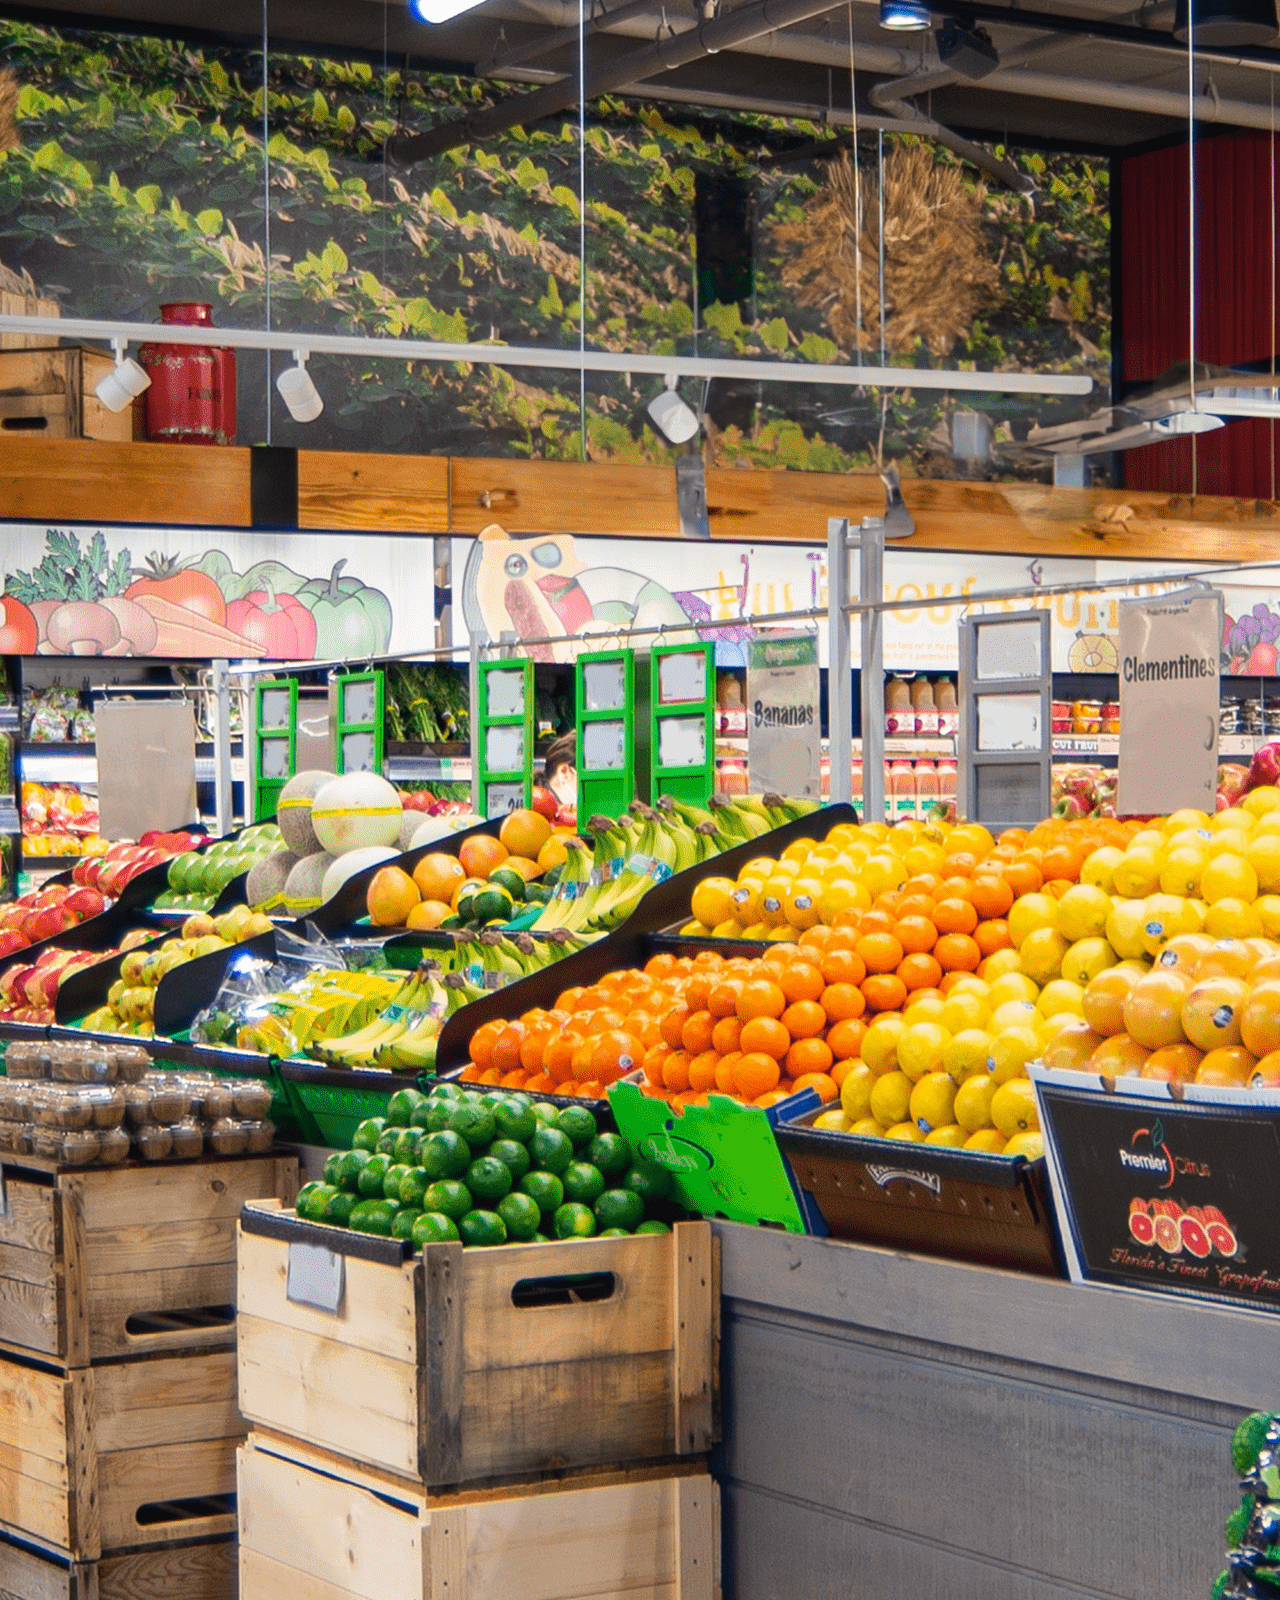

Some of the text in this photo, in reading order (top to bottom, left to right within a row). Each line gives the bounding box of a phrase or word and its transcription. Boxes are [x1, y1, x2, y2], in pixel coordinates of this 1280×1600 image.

[1123, 654, 1216, 683] Clementines
[754, 700, 813, 728] Bananas
[1052, 739, 1072, 750] CUT
[1119, 1149, 1168, 1173] Premier
[1110, 1248, 1166, 1270] Florida's
[1167, 1257, 1208, 1278] Finest
